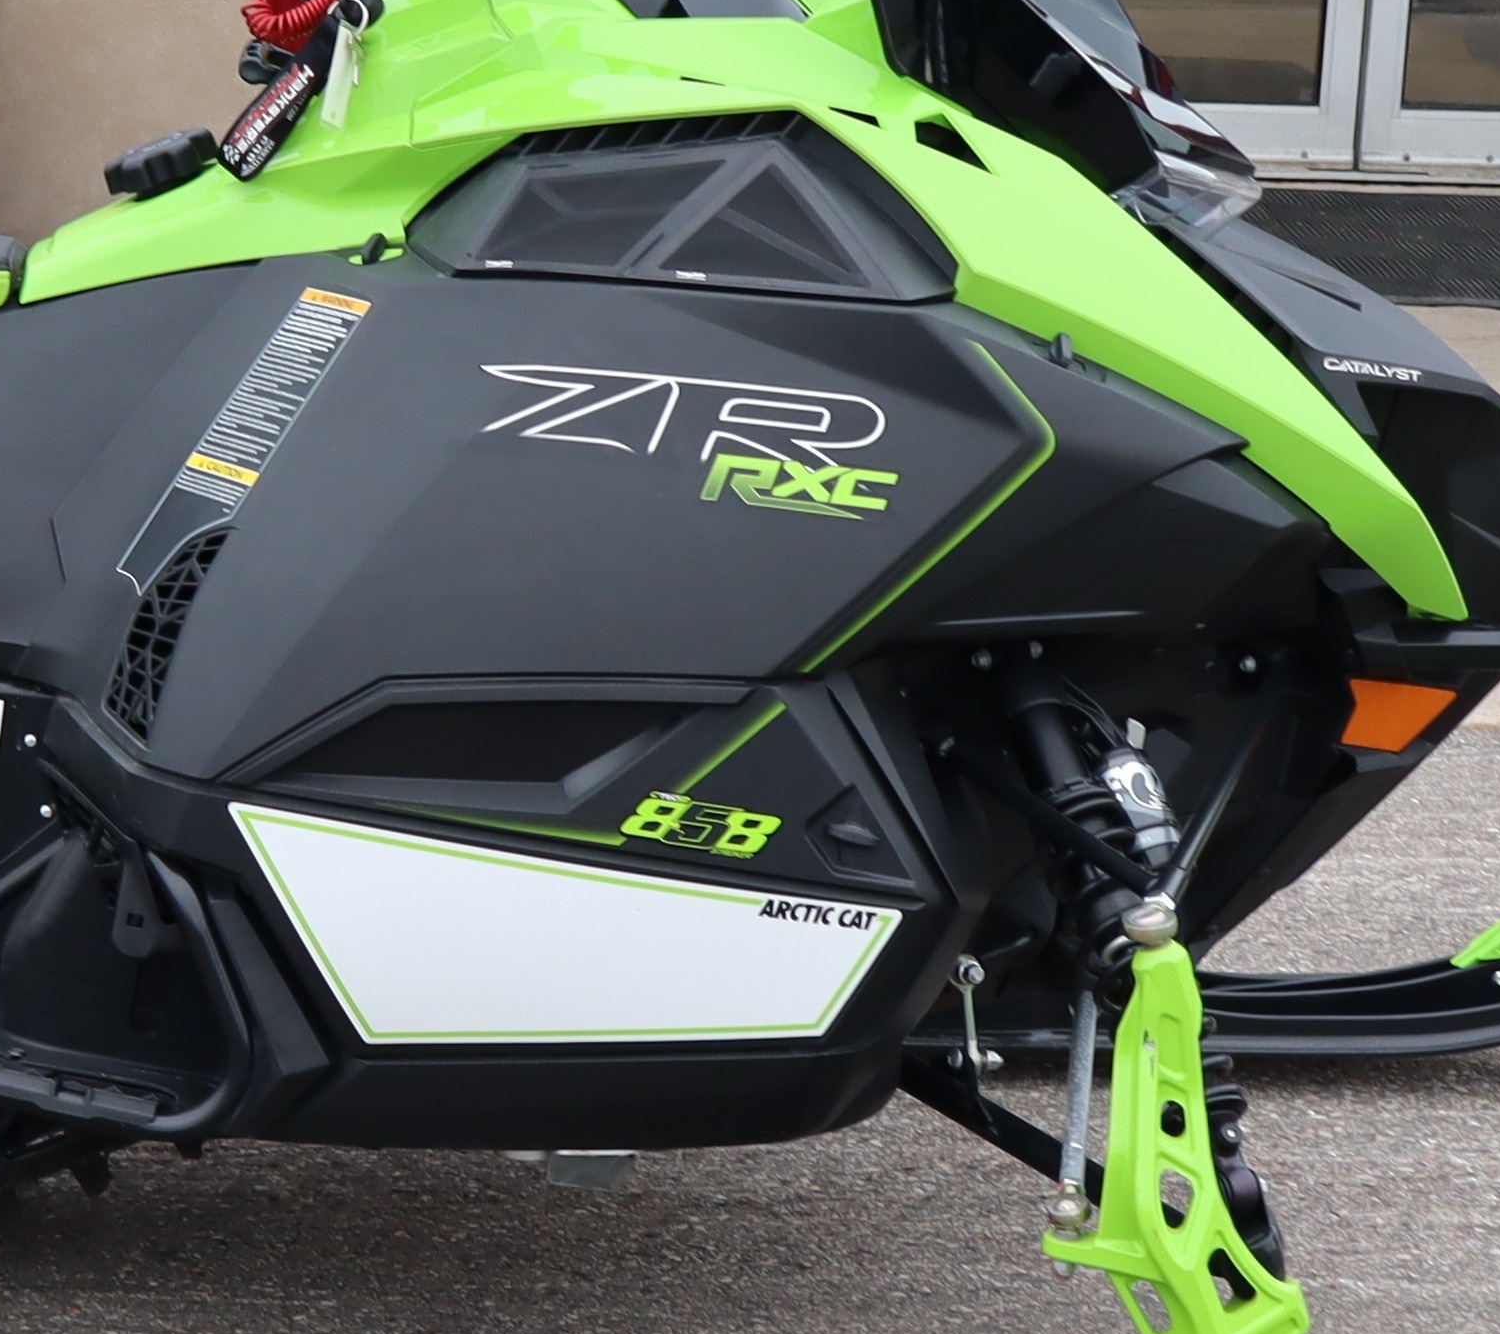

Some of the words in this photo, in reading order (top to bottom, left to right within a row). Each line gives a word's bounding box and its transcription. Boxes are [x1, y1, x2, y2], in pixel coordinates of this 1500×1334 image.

[1323, 357, 1422, 382] CATALYST
[479, 364, 886, 473] ZR
[700, 453, 899, 520] RXC
[619, 796, 783, 855] 858
[759, 898, 837, 926] ARCTIC
[837, 910, 877, 931] CAT
